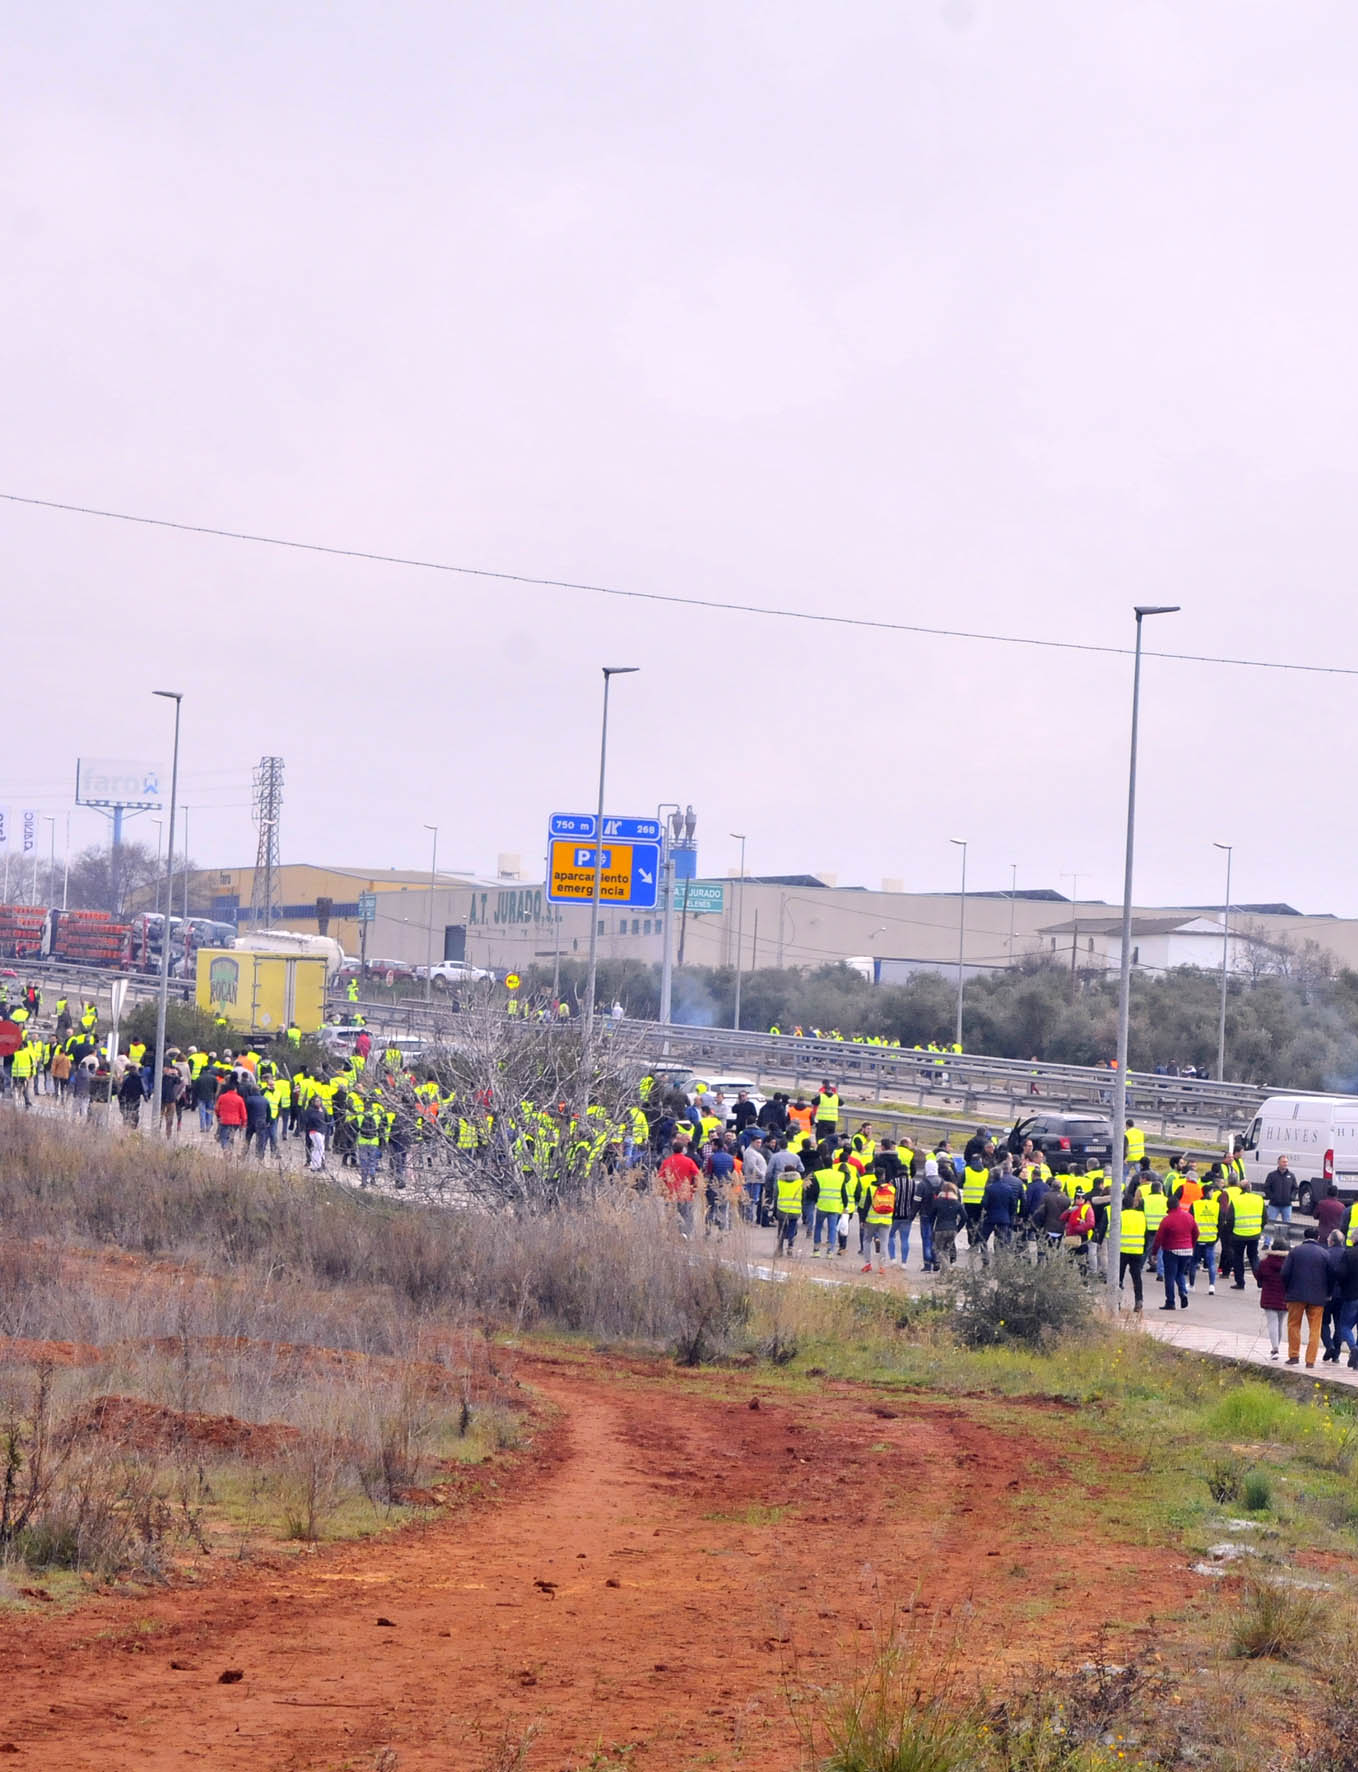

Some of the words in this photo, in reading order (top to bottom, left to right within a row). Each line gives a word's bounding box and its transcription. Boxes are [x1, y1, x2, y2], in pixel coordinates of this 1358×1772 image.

[556, 820, 575, 830] 750
[579, 822, 590, 831] m
[636, 825, 656, 835] 268
[577, 850, 591, 866] P
[554, 871, 629, 884] aparcaiento
[557, 883, 625, 897] emergncia
[688, 887, 721, 898] JURADO
[1266, 1126, 1319, 1143] HINVES
